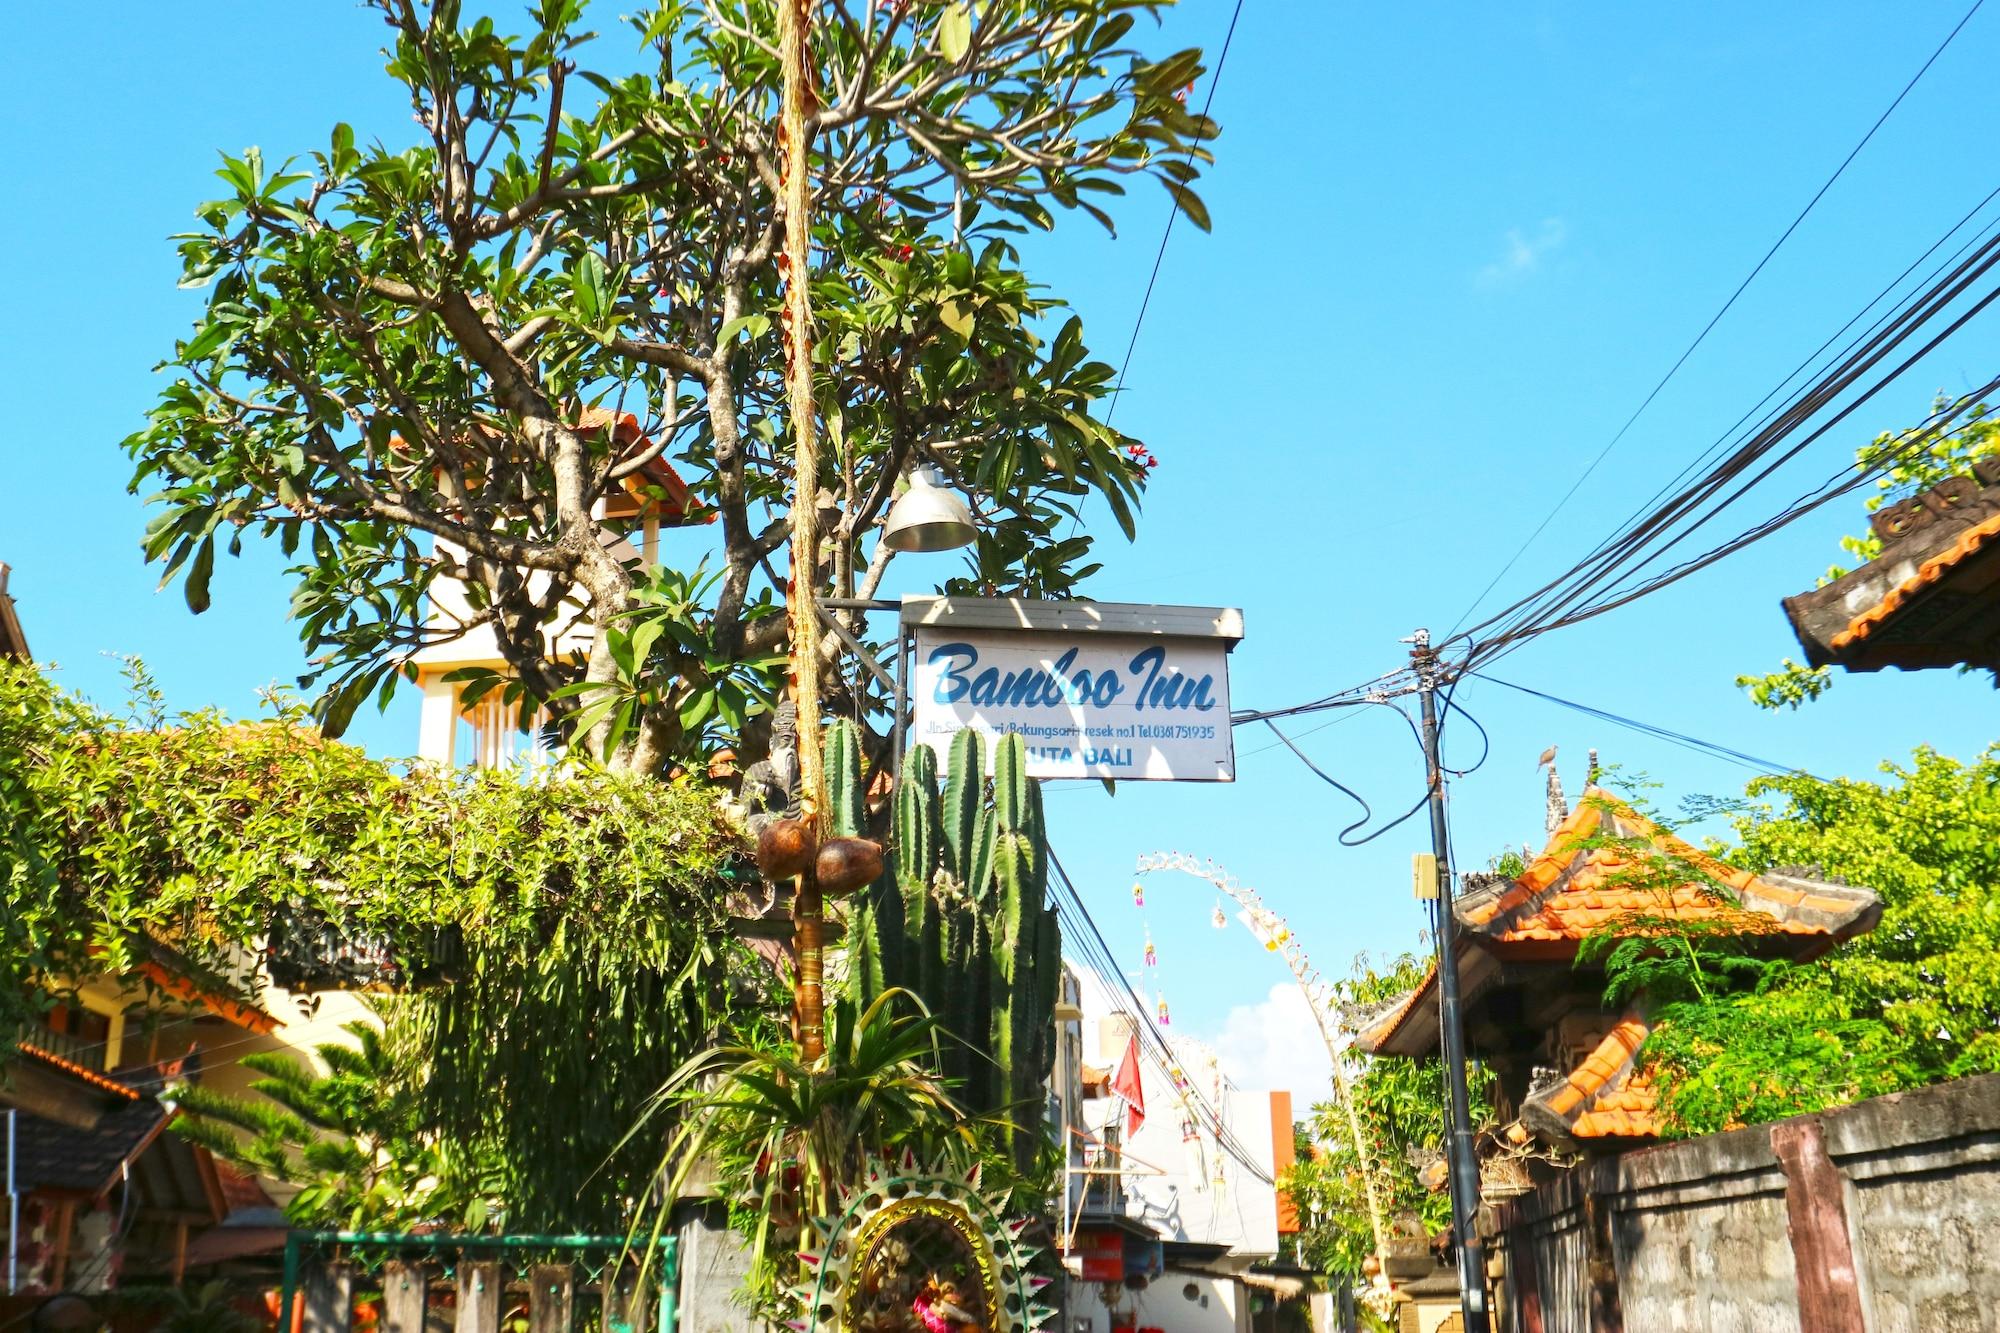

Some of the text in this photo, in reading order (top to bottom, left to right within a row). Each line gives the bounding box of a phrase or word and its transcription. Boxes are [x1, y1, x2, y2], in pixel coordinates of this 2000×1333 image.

[928, 643, 1216, 711] Bamboo Inn
[1116, 725, 1135, 738] no.1
[1024, 747, 1132, 766] UTA BALI
